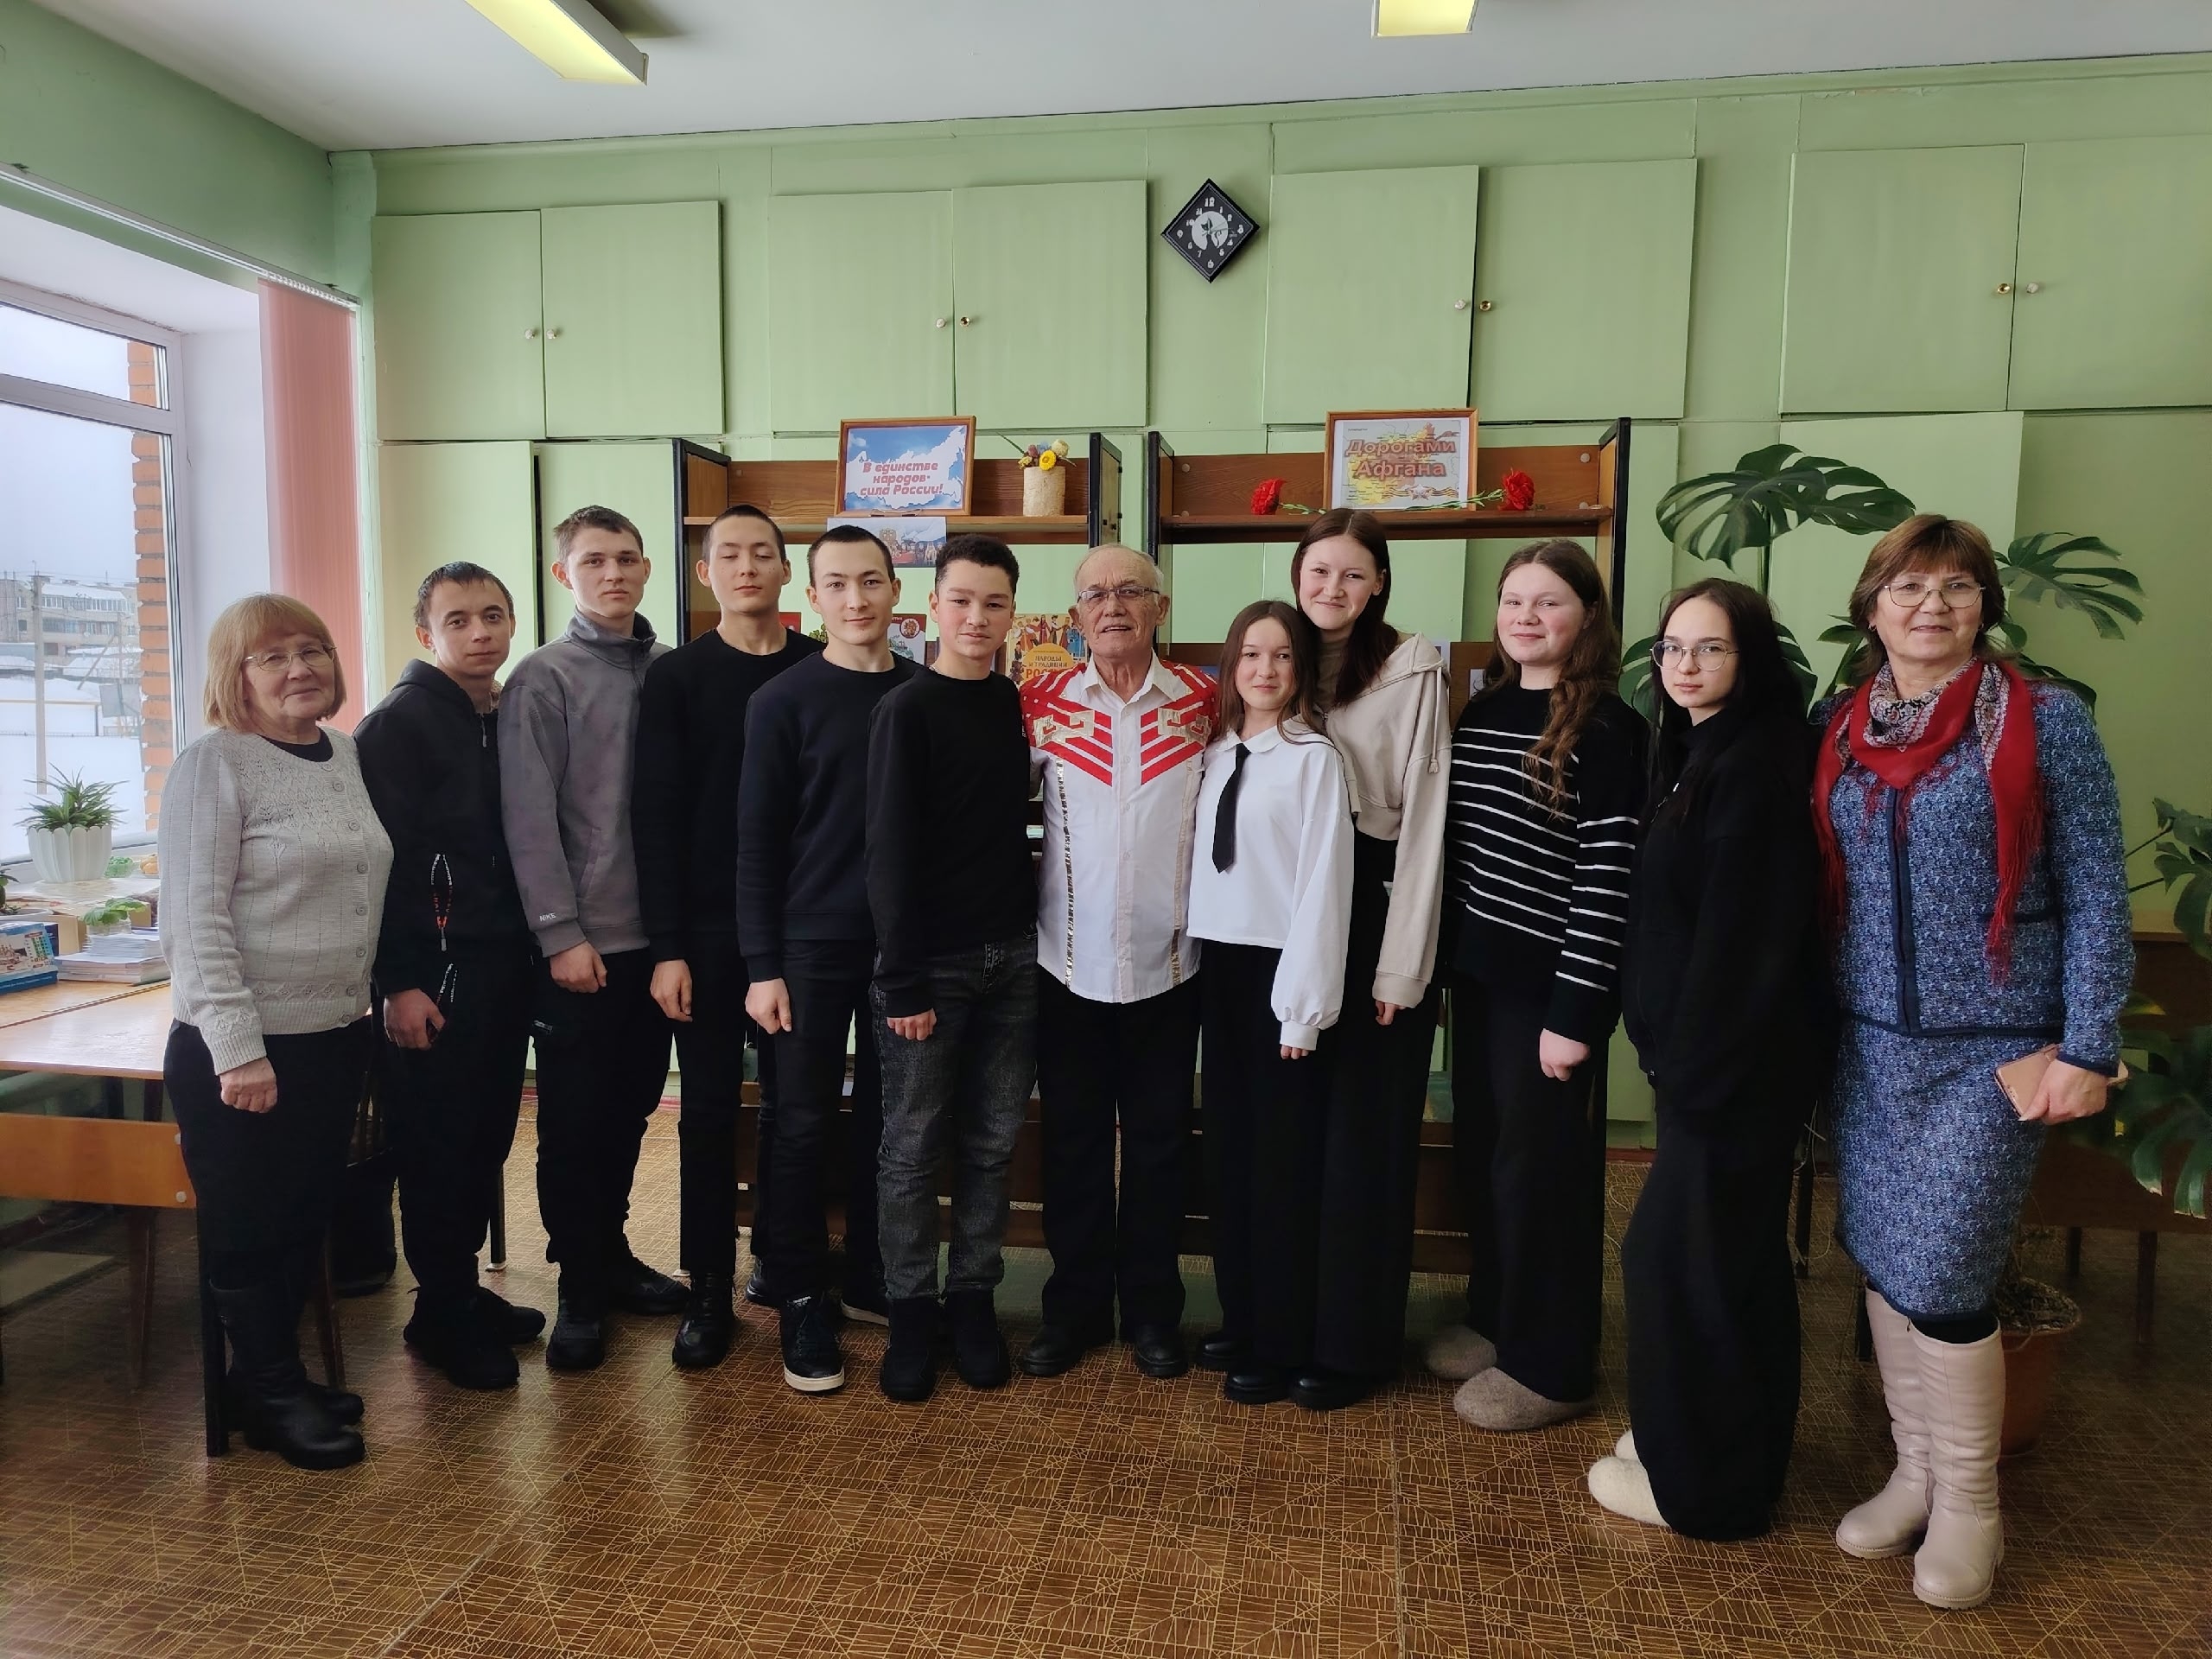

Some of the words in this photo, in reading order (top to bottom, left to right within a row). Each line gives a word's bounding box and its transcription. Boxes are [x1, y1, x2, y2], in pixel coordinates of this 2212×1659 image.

[1205, 197, 1215, 207] 12
[1177, 230, 1183, 238] 9
[1345, 440, 1456, 456] Дорогами
[862, 462, 872, 473] В
[875, 462, 938, 474] единстве
[1354, 460, 1446, 480] Афгана
[873, 474, 931, 486] народов-
[861, 486, 891, 496] сила
[893, 484, 944, 495] России!
